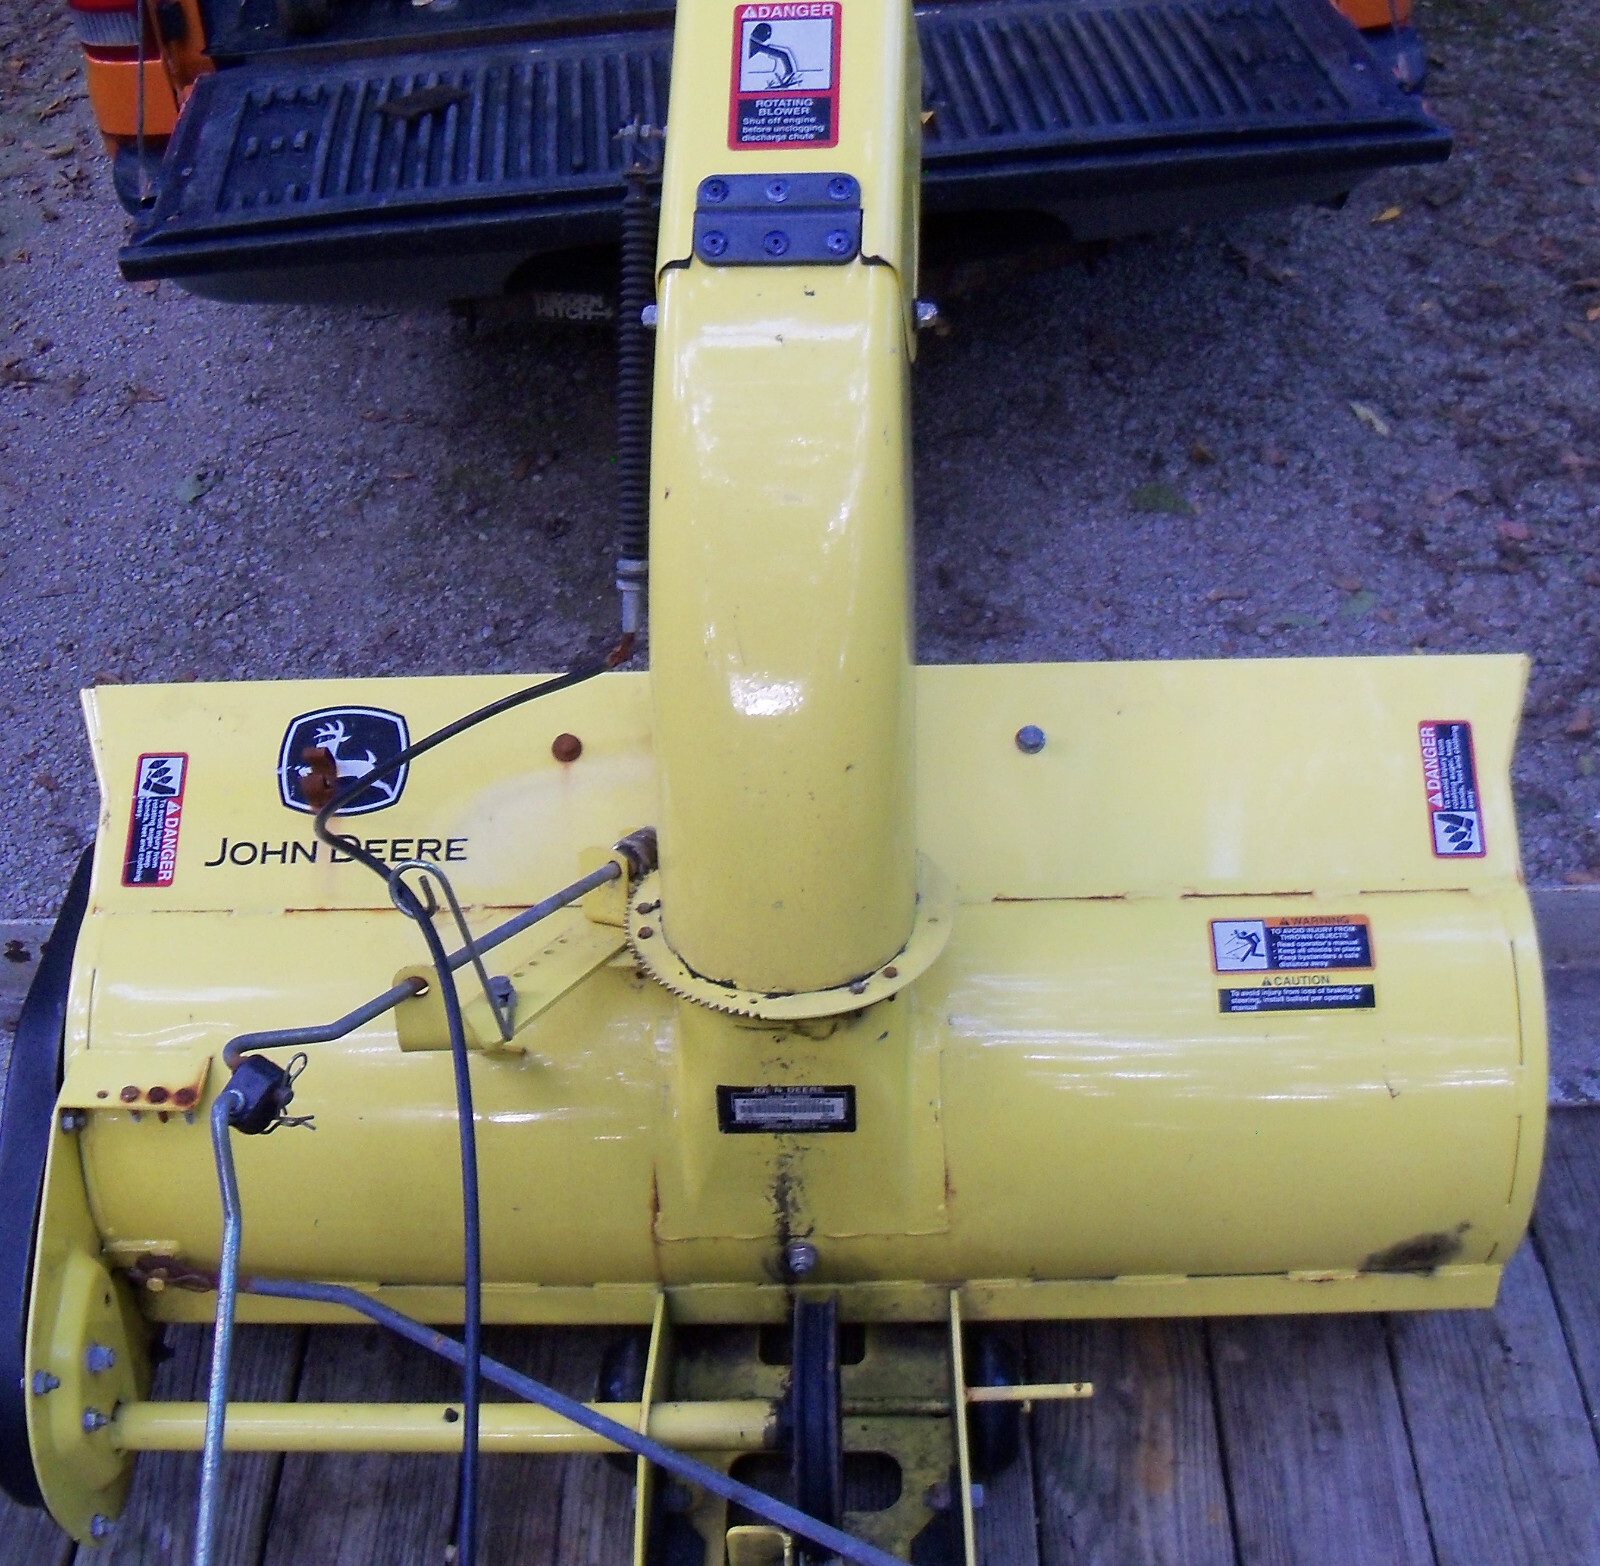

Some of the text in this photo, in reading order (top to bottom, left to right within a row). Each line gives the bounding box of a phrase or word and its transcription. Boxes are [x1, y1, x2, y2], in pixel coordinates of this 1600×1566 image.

[758, 5, 834, 18] DANGER
[756, 98, 813, 107] ROTATING
[758, 107, 810, 116] BLOWER
[783, 117, 816, 125] engine
[1445, 740, 1453, 755] keep
[1450, 726, 1460, 754] clothing
[1420, 727, 1440, 789] DANGER
[1439, 757, 1448, 777] injury
[1441, 779, 1449, 798] avoid
[1450, 782, 1459, 809] rotating
[142, 799, 151, 823] hands,
[159, 799, 166, 808] To
[148, 799, 158, 826] rotating
[139, 839, 147, 852] and
[153, 830, 162, 850] injury
[158, 818, 178, 880] DANGER
[204, 834, 468, 866] JOHN DEERE
[133, 854, 145, 882] clothing
[143, 851, 153, 868] keep
[152, 851, 160, 868] from
[1293, 916, 1349, 925] WARNING
[1274, 976, 1330, 985] CAUTION
[1262, 989, 1281, 997] injury
[1324, 994, 1359, 1002] operator's
